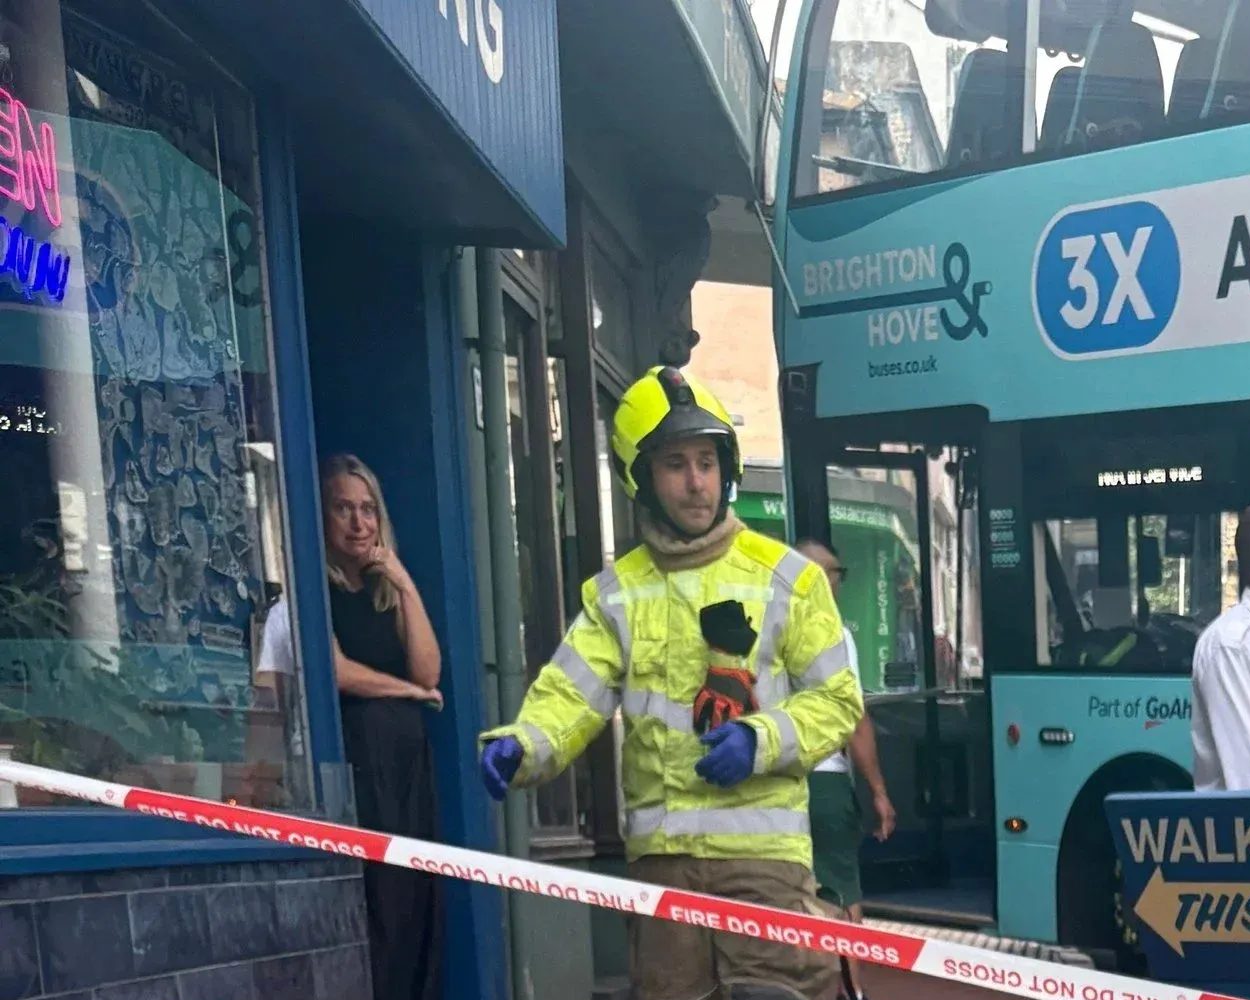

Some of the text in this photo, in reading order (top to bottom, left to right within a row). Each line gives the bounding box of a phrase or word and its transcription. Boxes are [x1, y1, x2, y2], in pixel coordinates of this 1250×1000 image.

[803, 244, 937, 296] BRIGHTON
[1059, 226, 1156, 329] 3X
[867, 306, 940, 348] HOVE
[867, 355, 938, 378] buses.co.uk
[1088, 696, 1120, 719] Part
[1123, 697, 1141, 719] of
[670, 905, 900, 964] FIRE DO NOT CROSS
[943, 958, 1022, 987] CROSS
[1029, 975, 1075, 998] NOT
